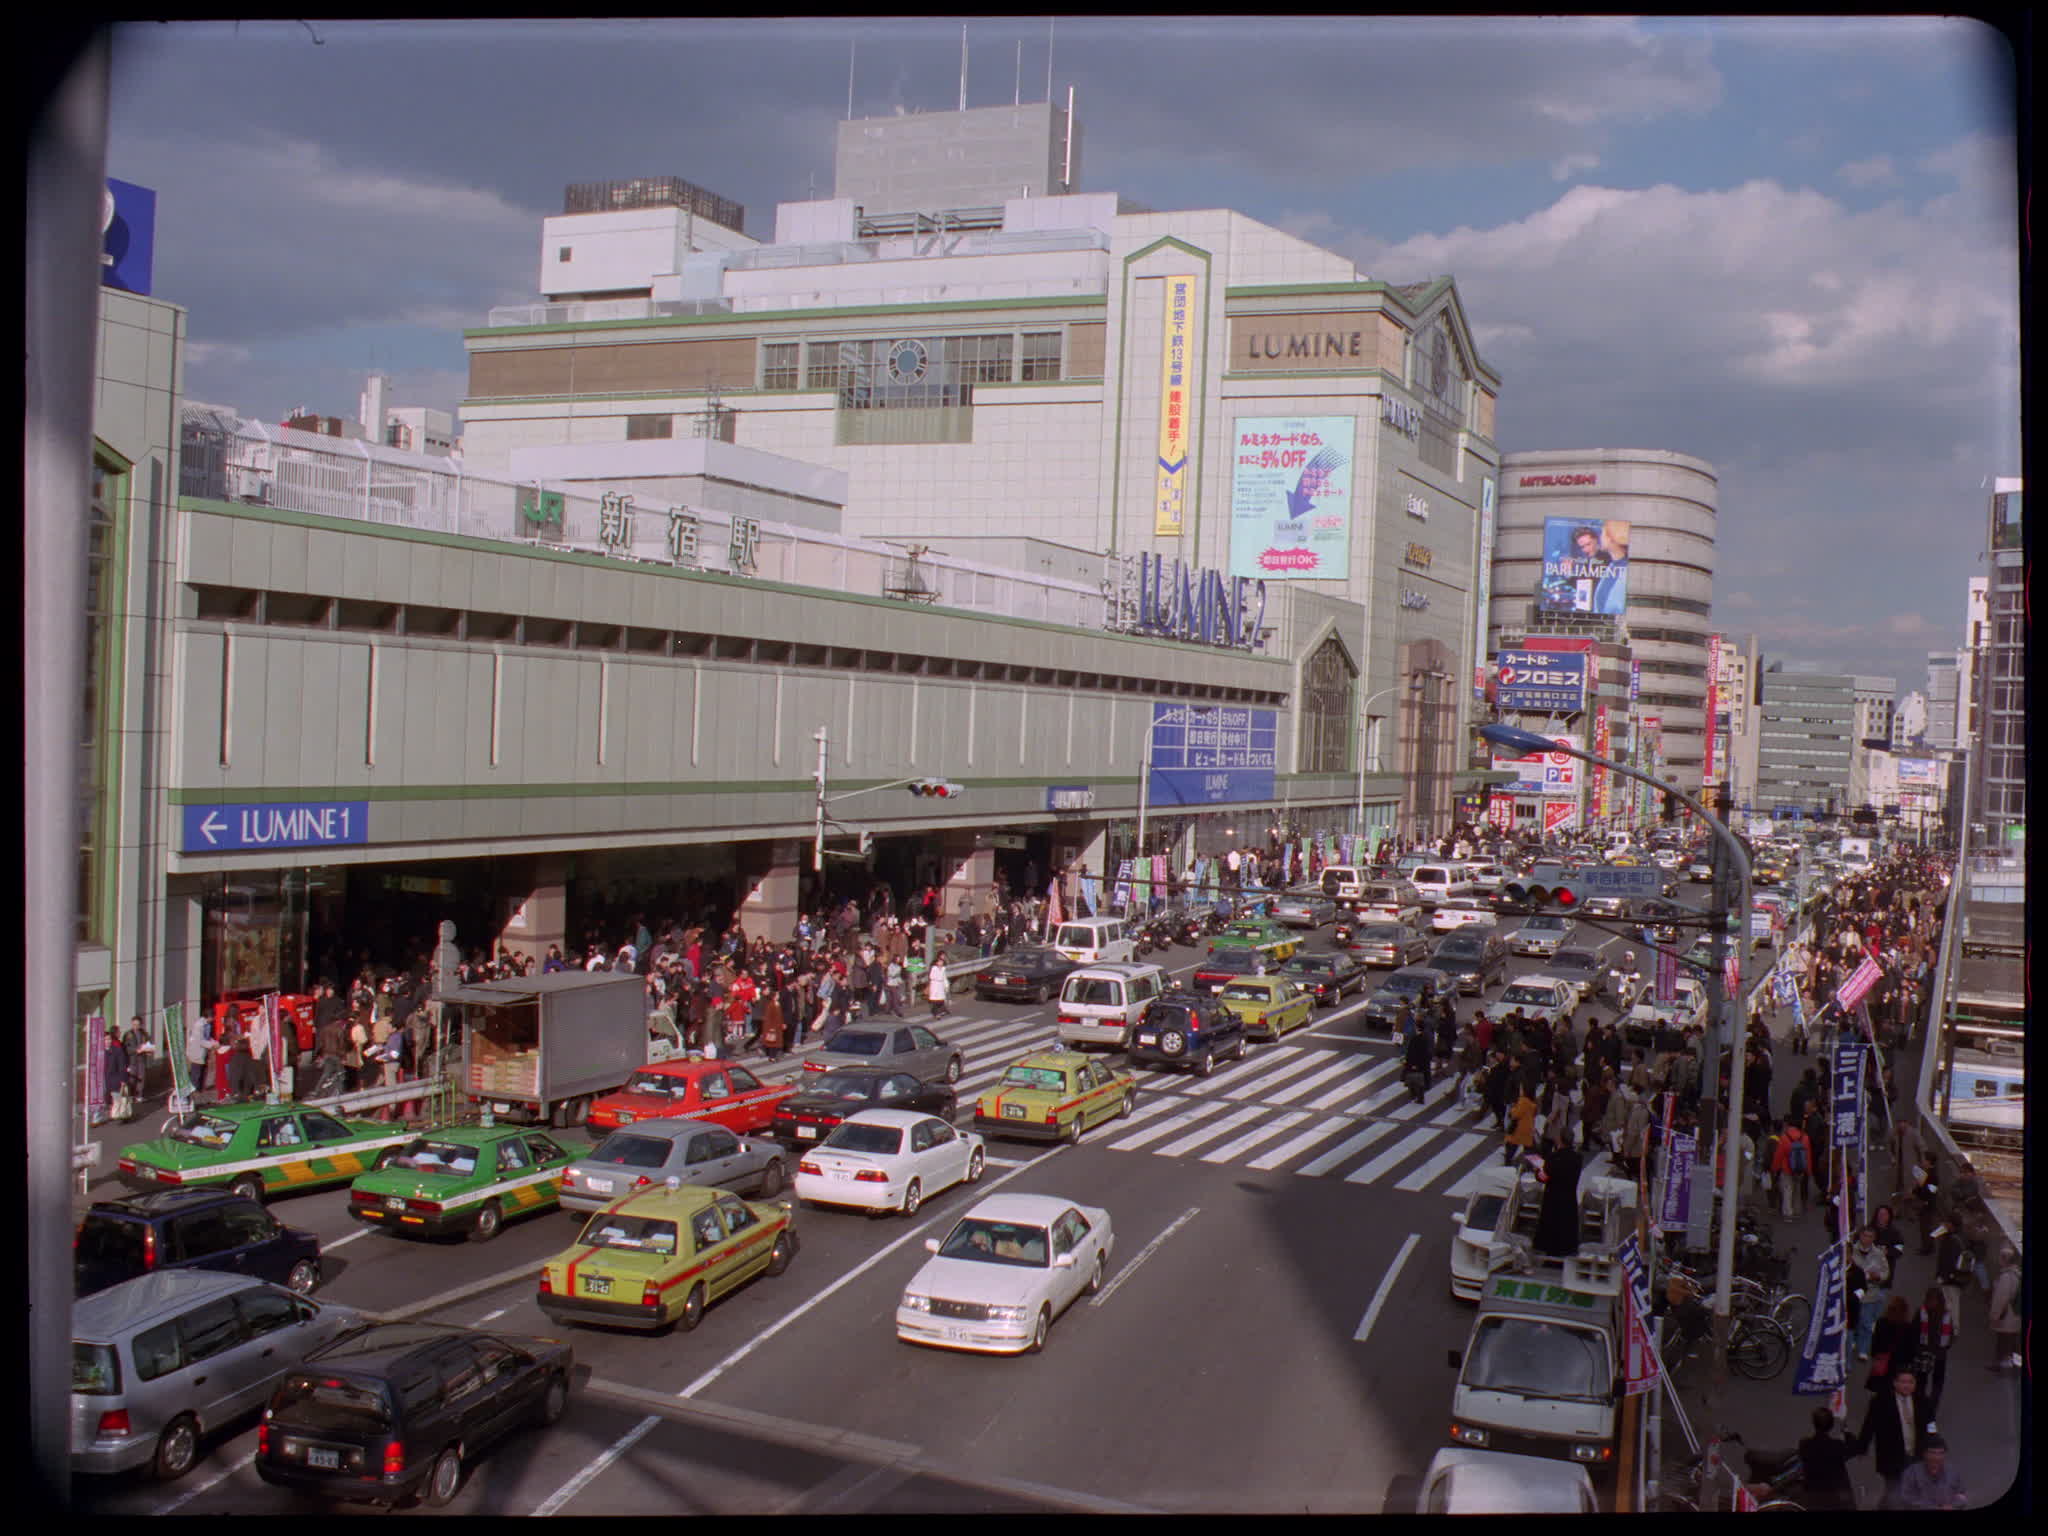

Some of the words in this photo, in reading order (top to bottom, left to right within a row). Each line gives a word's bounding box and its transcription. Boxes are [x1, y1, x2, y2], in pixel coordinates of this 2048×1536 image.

[1249, 331, 1361, 360] LUMINE
[1520, 474, 1597, 488] MITSUKOSHI
[525, 490, 562, 523] JR
[600, 491, 760, 570] 新宿駅
[1545, 562, 1625, 578] PARLIAMENT
[1548, 770, 1558, 781] P
